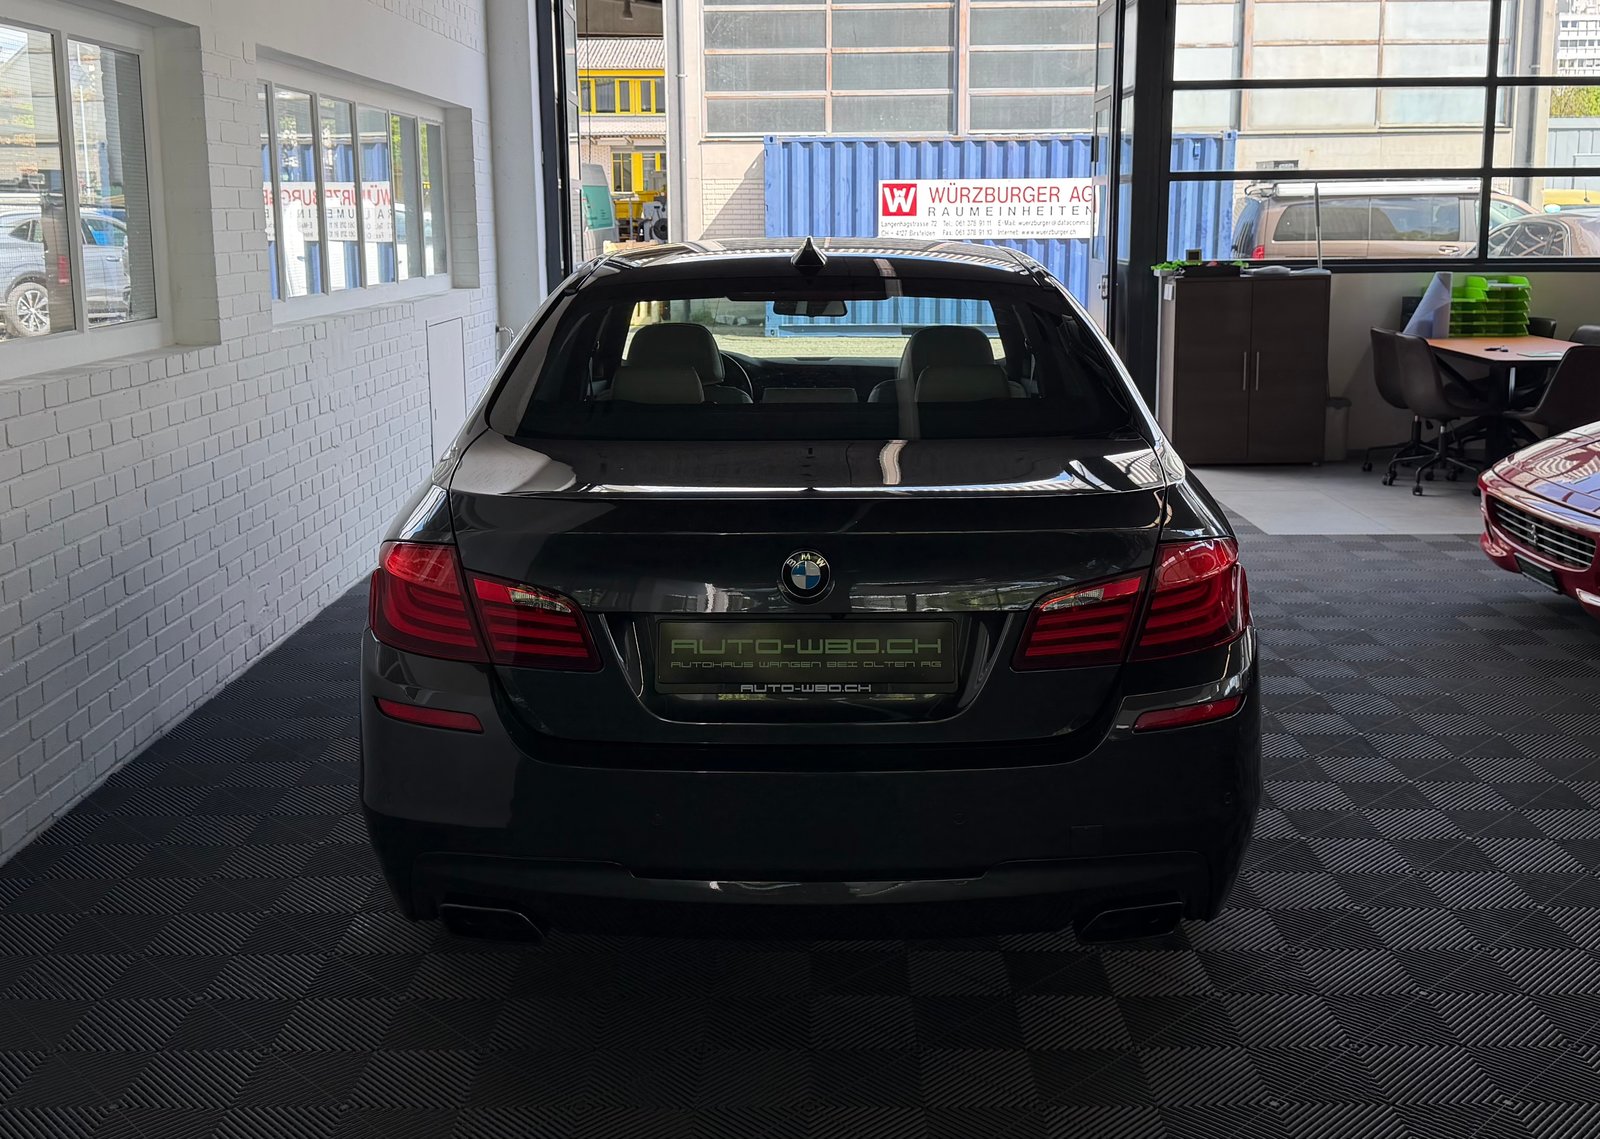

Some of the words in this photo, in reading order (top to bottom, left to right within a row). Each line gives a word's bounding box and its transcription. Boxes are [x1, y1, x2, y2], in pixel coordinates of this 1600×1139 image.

[929, 182, 1060, 204] WÜRZBURGER
[1069, 185, 1092, 203] AG
[928, 206, 1092, 216] RAUMEINHEITEN
[1018, 219, 1090, 228] wuerzburger@datacomm.c
[955, 228, 965, 236] 061
[979, 228, 985, 236] 91
[987, 228, 993, 236] 10
[786, 552, 826, 568] BMW
[670, 638, 942, 655] AUTO-WBO.CH
[740, 684, 872, 693] AUTO-WBO.CH
